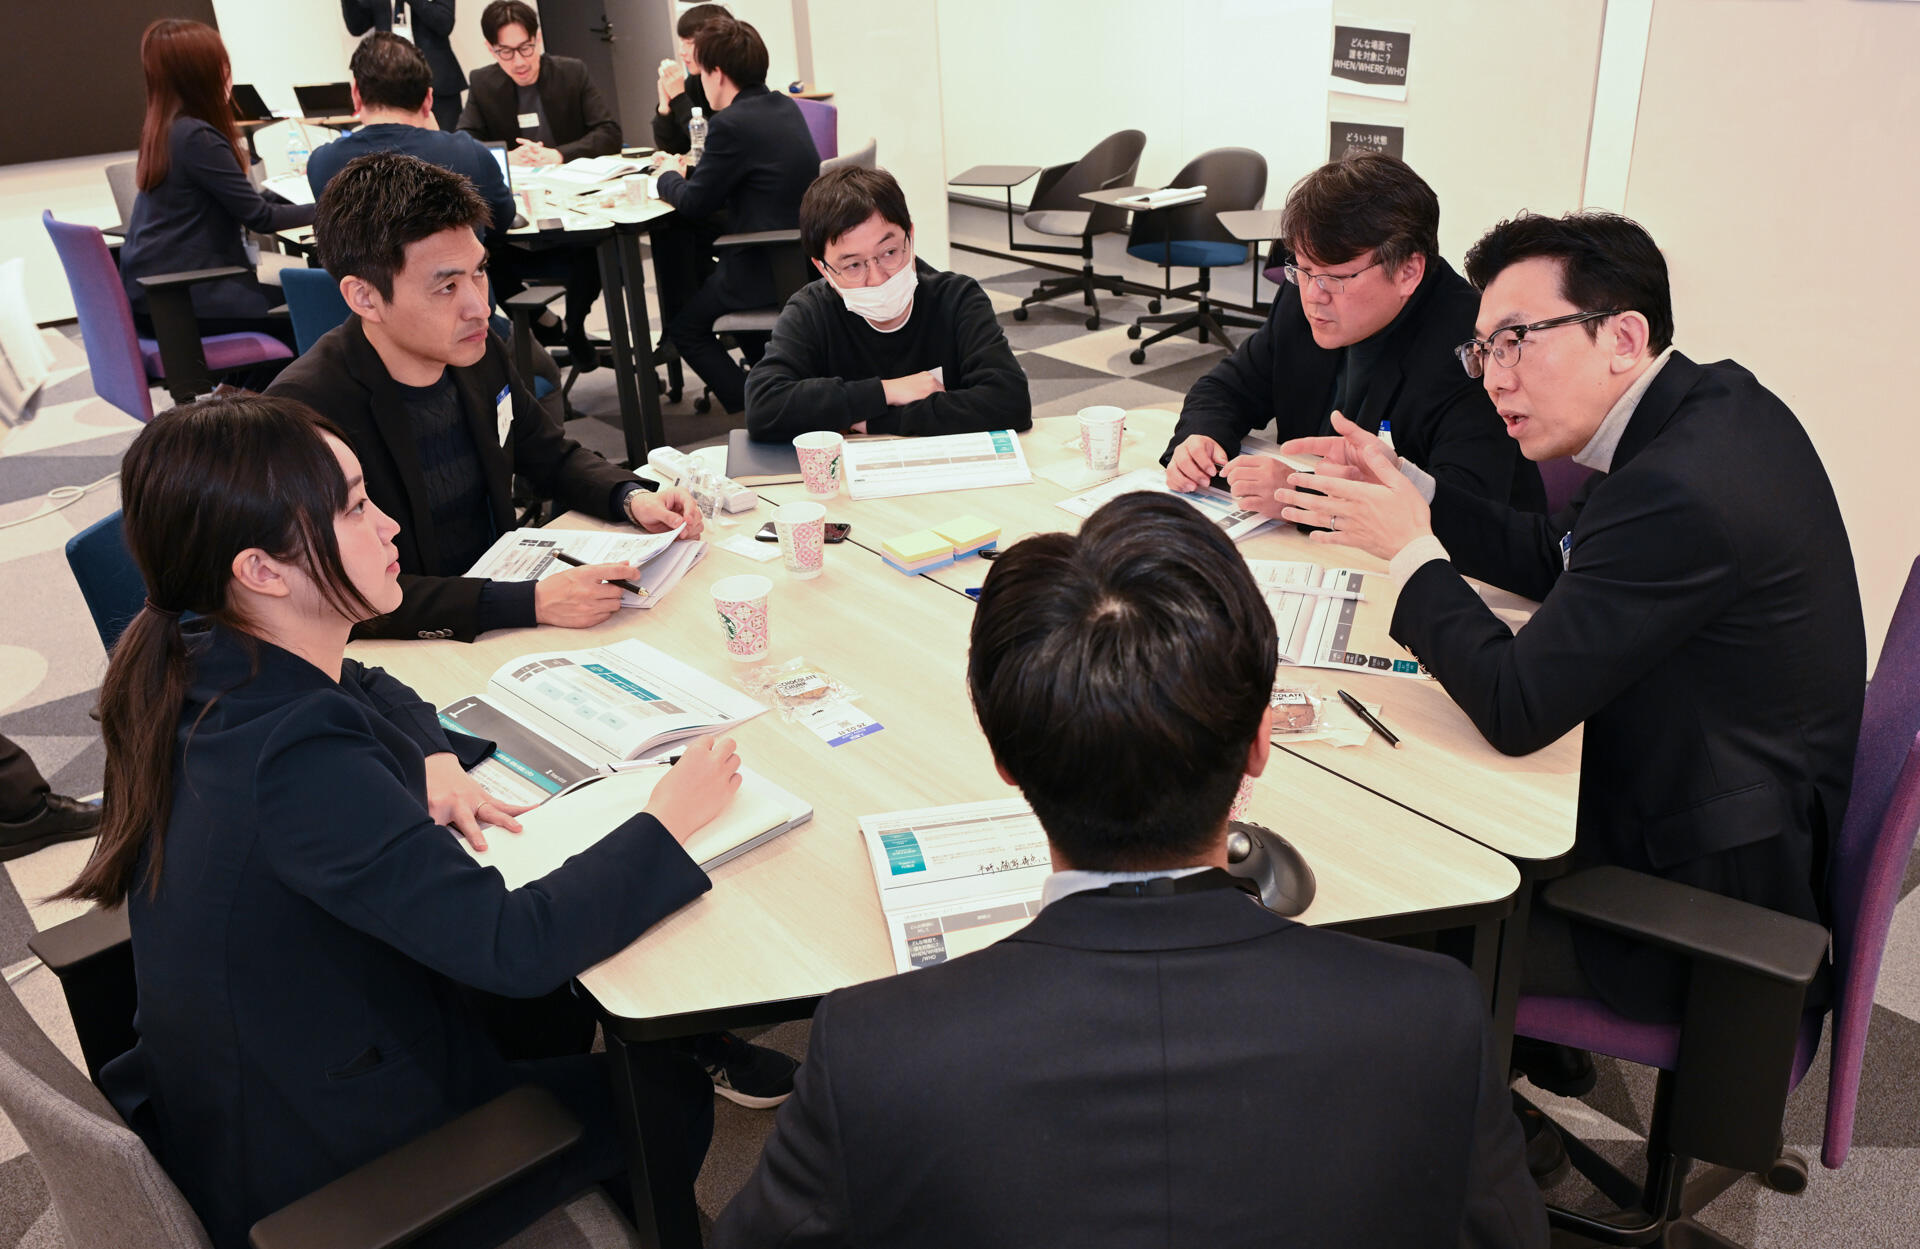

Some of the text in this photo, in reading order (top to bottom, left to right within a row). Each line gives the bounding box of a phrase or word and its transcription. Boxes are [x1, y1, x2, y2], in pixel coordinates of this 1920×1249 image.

[1350, 38, 1393, 52] どんな場面で
[1334, 59, 1406, 77] WHEN/WHERE/WHO
